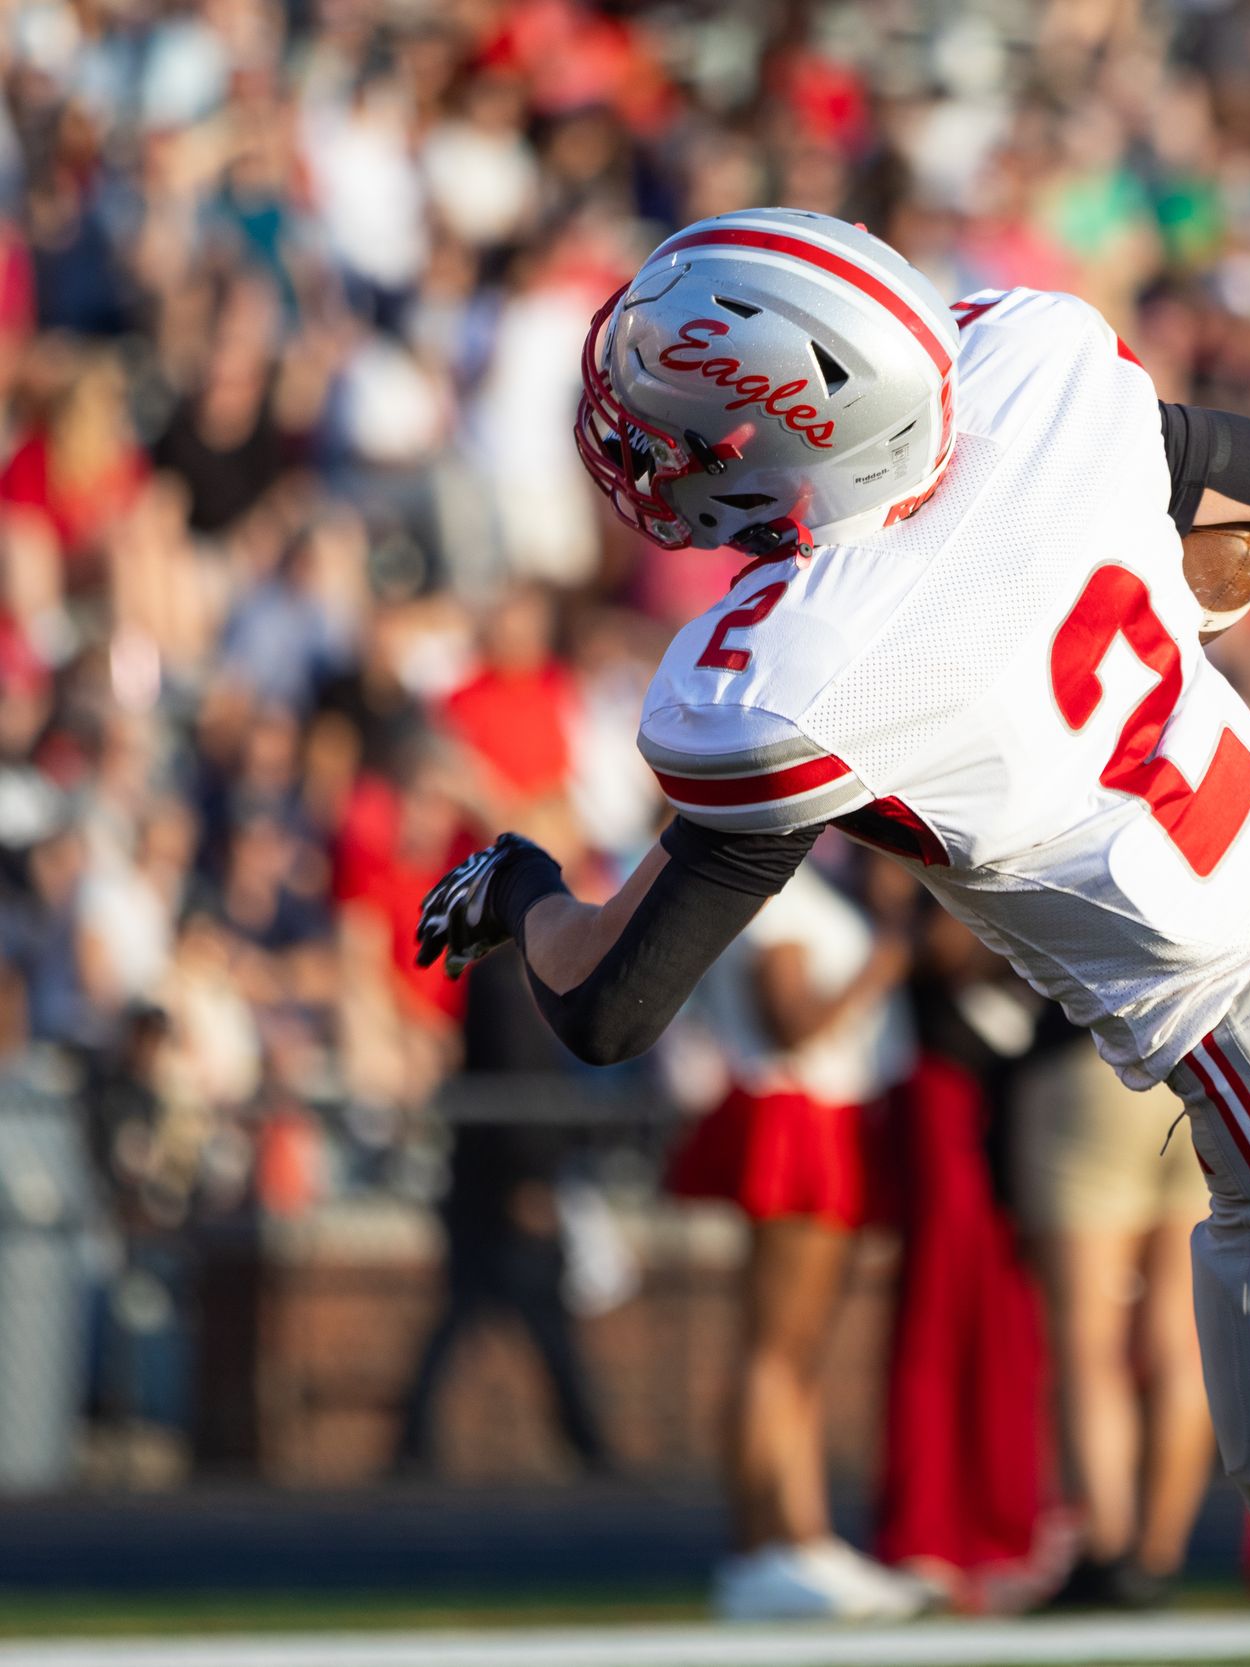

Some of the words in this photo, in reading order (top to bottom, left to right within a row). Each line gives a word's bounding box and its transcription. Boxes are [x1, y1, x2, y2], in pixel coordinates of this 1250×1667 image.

[658, 318, 835, 449] Eagles
[854, 468, 888, 484] Riddell
[693, 581, 790, 675] 2
